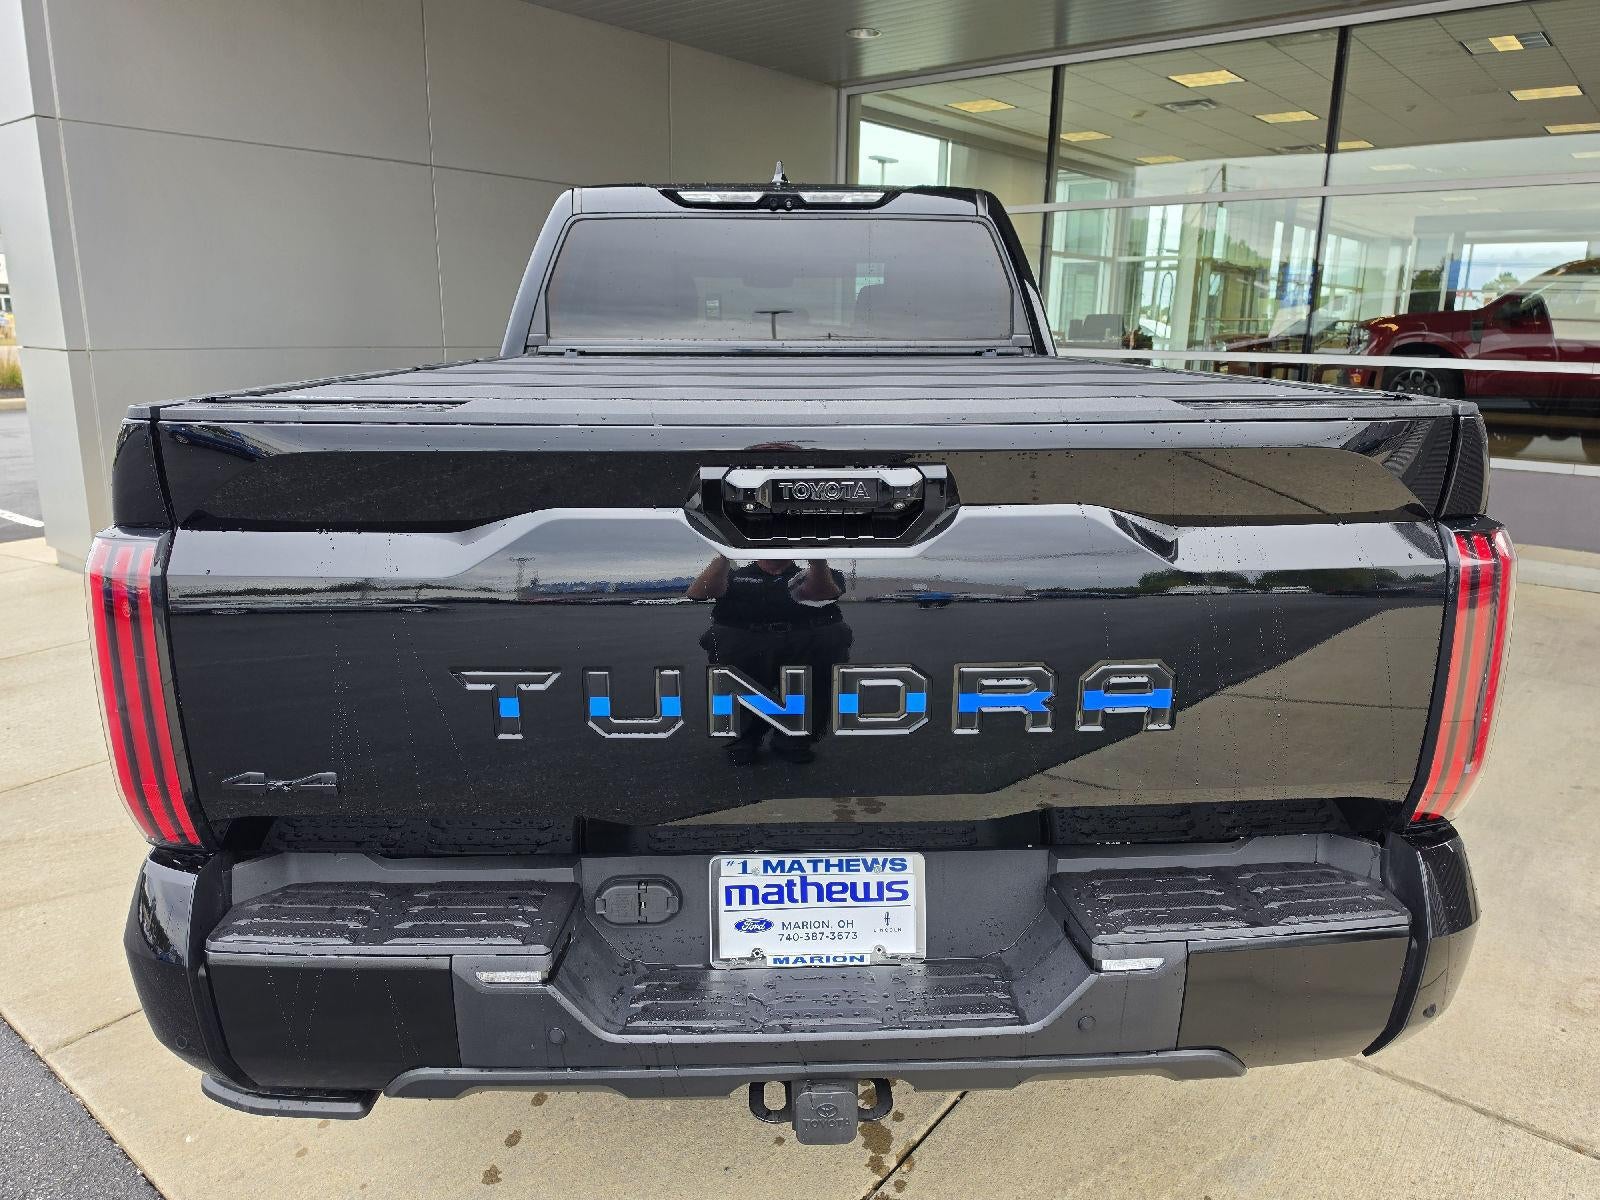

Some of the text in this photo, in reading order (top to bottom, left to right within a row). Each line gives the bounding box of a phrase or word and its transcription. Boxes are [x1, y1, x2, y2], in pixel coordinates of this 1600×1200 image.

[779, 481, 871, 500] TOYOTA
[450, 659, 1177, 738] TUNDRA
[762, 857, 908, 874] MATHEWS
[724, 875, 910, 907] mathews
[837, 919, 854, 929] OH
[772, 954, 865, 965] MARION
